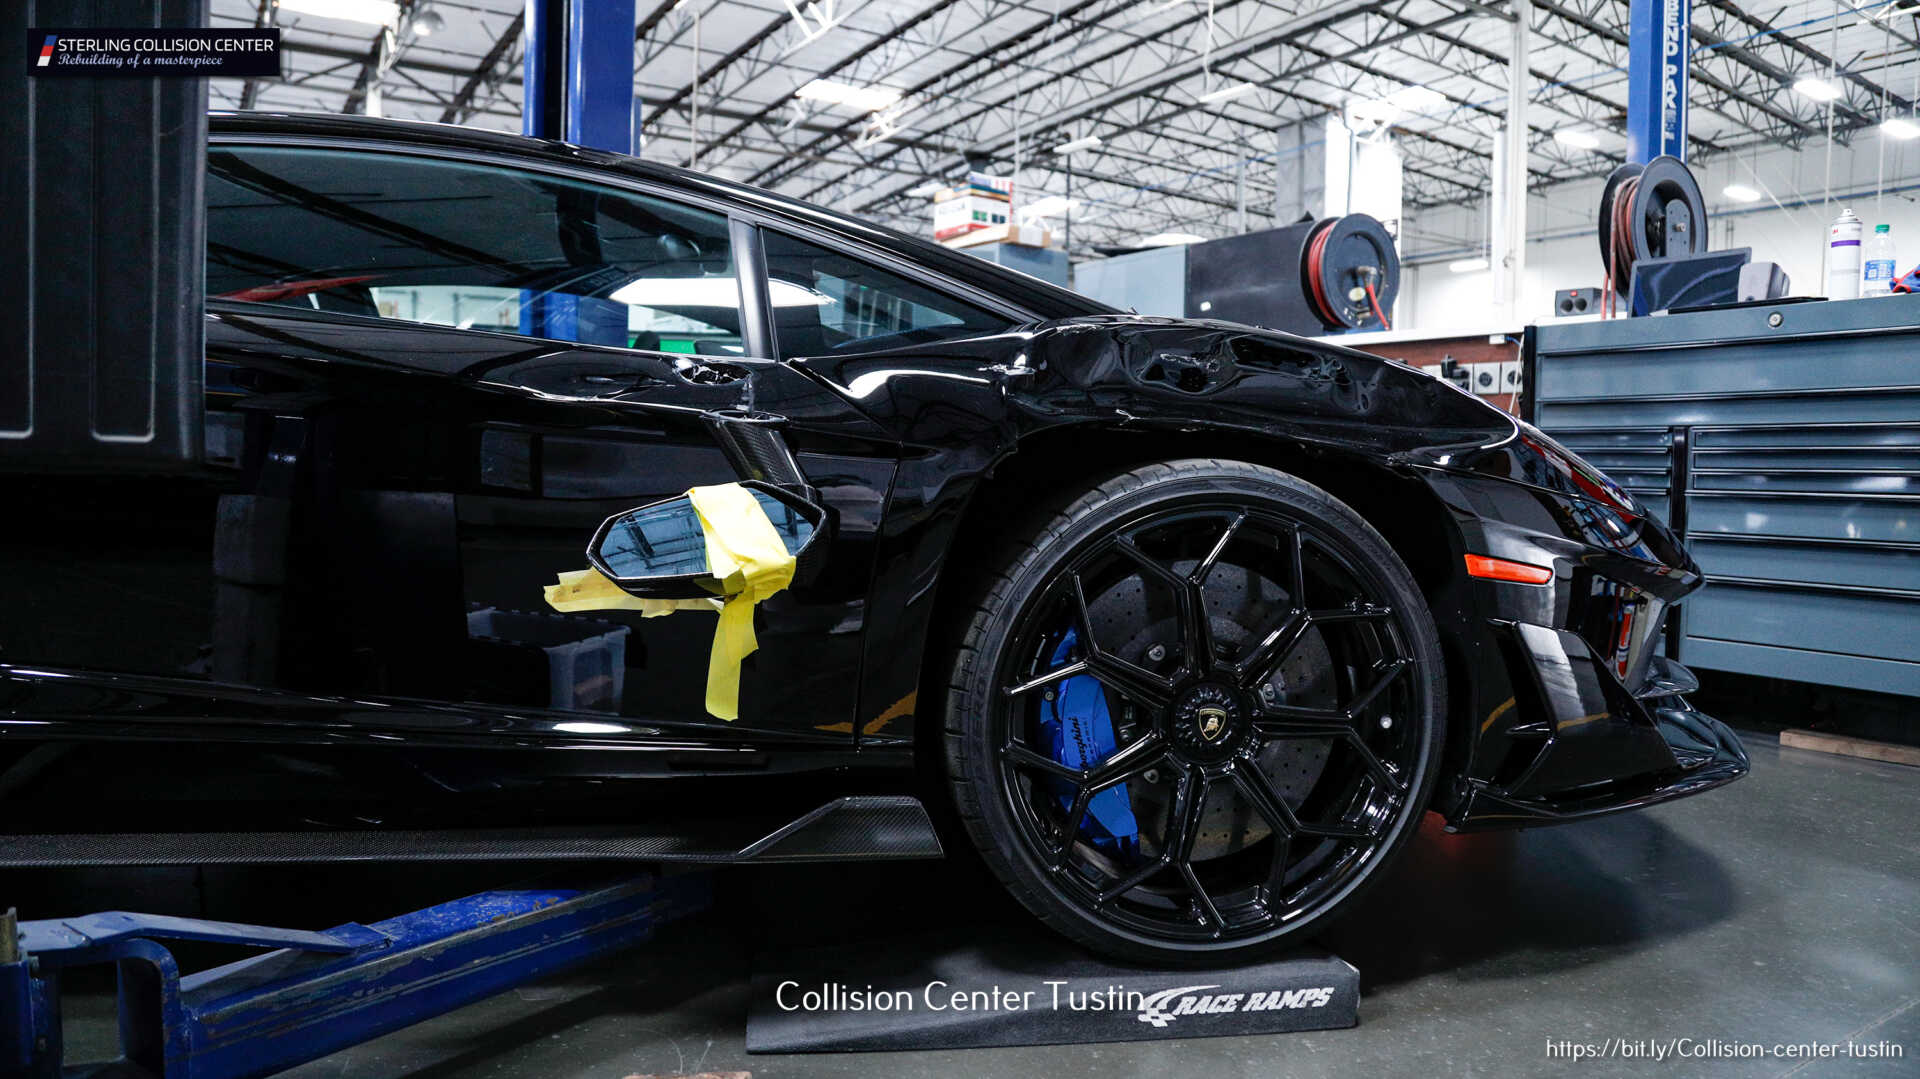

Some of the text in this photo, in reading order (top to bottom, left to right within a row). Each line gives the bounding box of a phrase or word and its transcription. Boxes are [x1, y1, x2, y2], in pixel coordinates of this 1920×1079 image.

[1666, 0, 1680, 56] BEND
[1665, 64, 1678, 109] PAK
[1173, 987, 1335, 1015] RACE RAMPS
